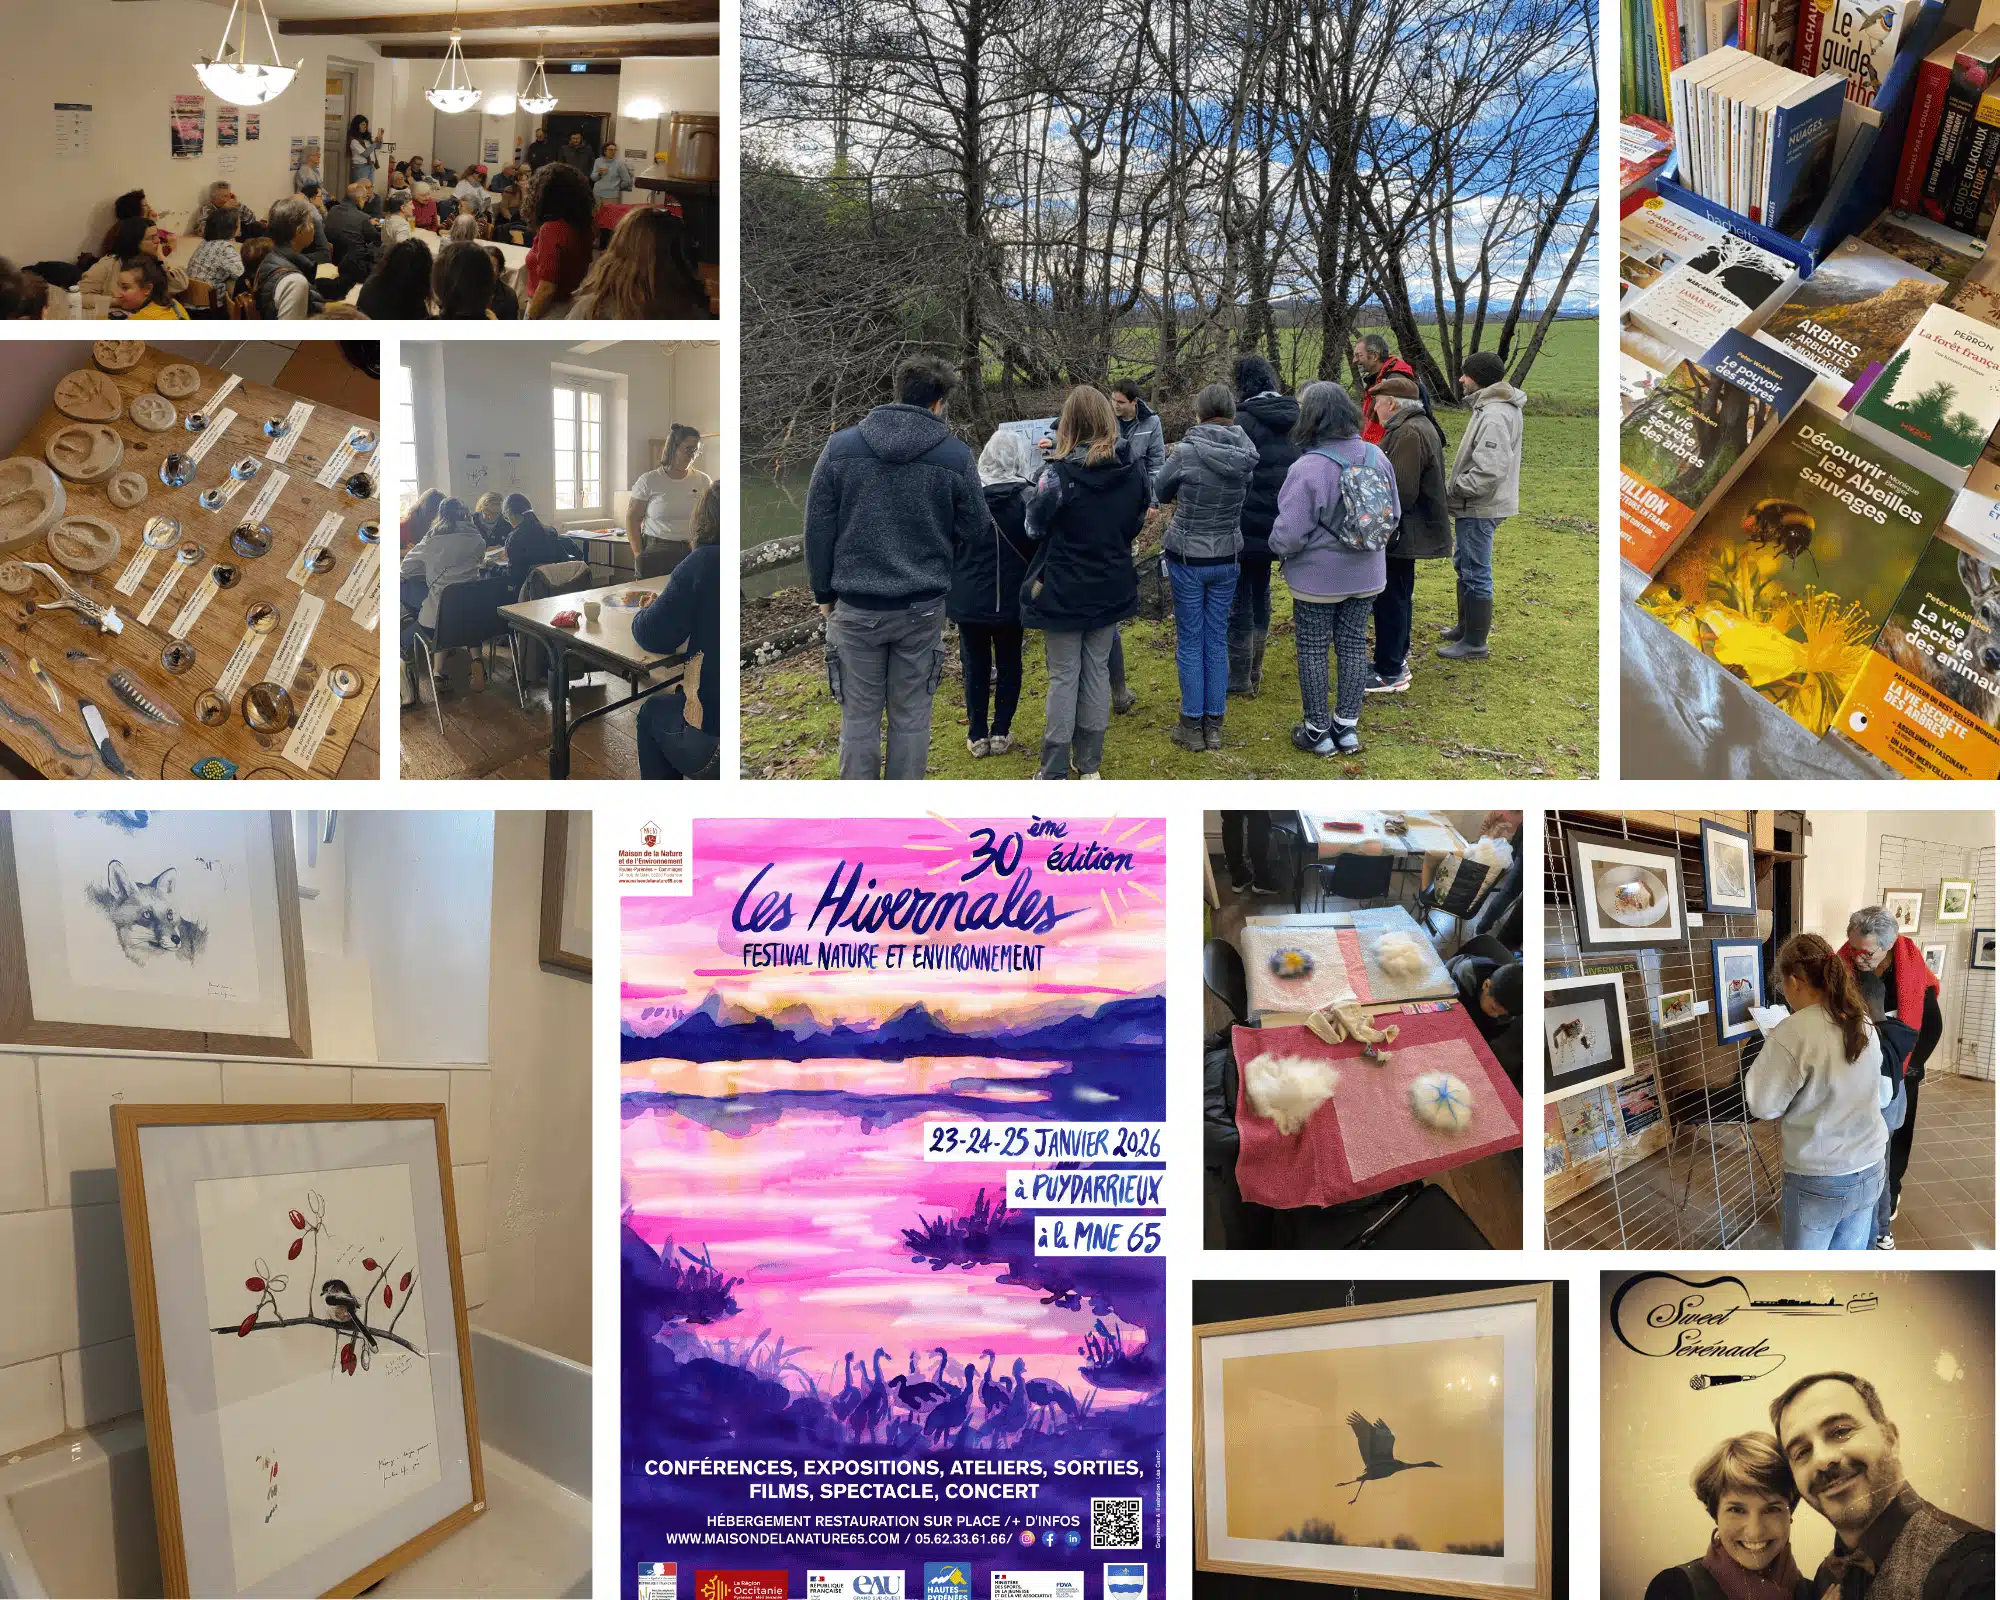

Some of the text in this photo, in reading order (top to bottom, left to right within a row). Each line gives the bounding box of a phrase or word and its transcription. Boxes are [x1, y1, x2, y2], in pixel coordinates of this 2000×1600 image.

[1832, 0, 1853, 36] Le
[1822, 38, 1871, 77] guide
[1918, 93, 1933, 127] COULEUR
[1788, 118, 1824, 148] NUAGES
[1913, 139, 1921, 152] PAR
[1916, 128, 1923, 138] LA
[1937, 110, 1955, 155] CHAMPIGNONS
[1943, 141, 1954, 161] FRANCE
[1951, 113, 1963, 134] EUROPE
[1929, 167, 1940, 185] GUIDE
[1933, 155, 1943, 167] DES
[1953, 180, 1971, 214] GUIDE
[1962, 125, 1988, 180] DELACHAUX
[1964, 166, 1988, 219] DES FLEURS
[1646, 209, 1676, 227] CHANTS
[1676, 224, 1687, 233] ET
[1688, 230, 1705, 241] CRIS
[1706, 209, 1759, 246] hachette
[1768, 201, 1776, 228] NUAGES
[1678, 287, 1705, 305] JAMAIS
[1704, 300, 1722, 314] SEUL
[1795, 333, 1852, 369] ARBUSTES
[1797, 319, 1862, 359] ARBRES
[1918, 328, 1932, 339] La
[1933, 334, 1961, 352] forêt
[1961, 347, 2000, 372] frança
[1954, 329, 1994, 352] PERRON
[1736, 351, 1754, 364] Peter
[1782, 337, 1845, 376] DE MONTAGNE
[1715, 364, 1775, 403] des arbres
[1722, 355, 1783, 394] Le pouvoir
[1657, 405, 1694, 432] La vie
[1668, 396, 1686, 409] Peter
[1639, 424, 1705, 469] des arbres
[1648, 415, 1695, 448] secrète
[1798, 424, 1887, 480] Découvrir
[1799, 466, 1888, 525] sauvages
[1818, 454, 1923, 525] les Abeilles
[1884, 479, 1909, 497] Berger
[1888, 474, 1920, 496] Monique
[1638, 506, 1650, 517] EN
[1645, 511, 1672, 532] FRANCE
[1918, 603, 1965, 640] La vie
[1926, 591, 1992, 635] Peter Wohlleben
[1905, 631, 1935, 656] des
[1911, 618, 1974, 662] secrète
[1881, 689, 1907, 711] DES
[1902, 704, 1949, 739] ARBRES
[1887, 680, 1905, 697] LA
[1901, 689, 1923, 708] VIE
[1917, 699, 1971, 741] SECRÈTE
[1893, 671, 2000, 745] PAR L'AUTEUR DU BEST-SELLER MONDIAL
[1889, 736, 1900, 746] UN
[1897, 741, 1917, 758] LIVRE
[1895, 721, 1936, 751] ABSOLUMENT
[1932, 746, 1971, 774] FASCINANT.
[960, 814, 1136, 882] 30 ème édition
[731, 860, 1092, 937] Les Hivernales
[743, 941, 1046, 972] FESTIVAL NATURE ET ENVIRONNEMENT
[929, 1127, 1161, 1158] 23-24-25 JANVIER 2026
[1014, 1174, 1164, 1207] à PUYDARRIEUX
[1038, 1220, 1161, 1253] à la MNE 65
[644, 1457, 1144, 1478] CONFÉRENCES, EXPOSITIONS, ATELIERS, SORTIES,
[749, 1483, 1040, 1502] FILMS, SPECTACLE, CONCERT
[707, 1513, 1080, 1527] HÉBERGEMENT RESTAURATION SUR PLACE D'INFOS
[666, 1533, 1013, 1545] WWW.MAISONDELANATURE65.COM / 05.62.33.61.66/
[734, 1586, 783, 1595] Occitanie
